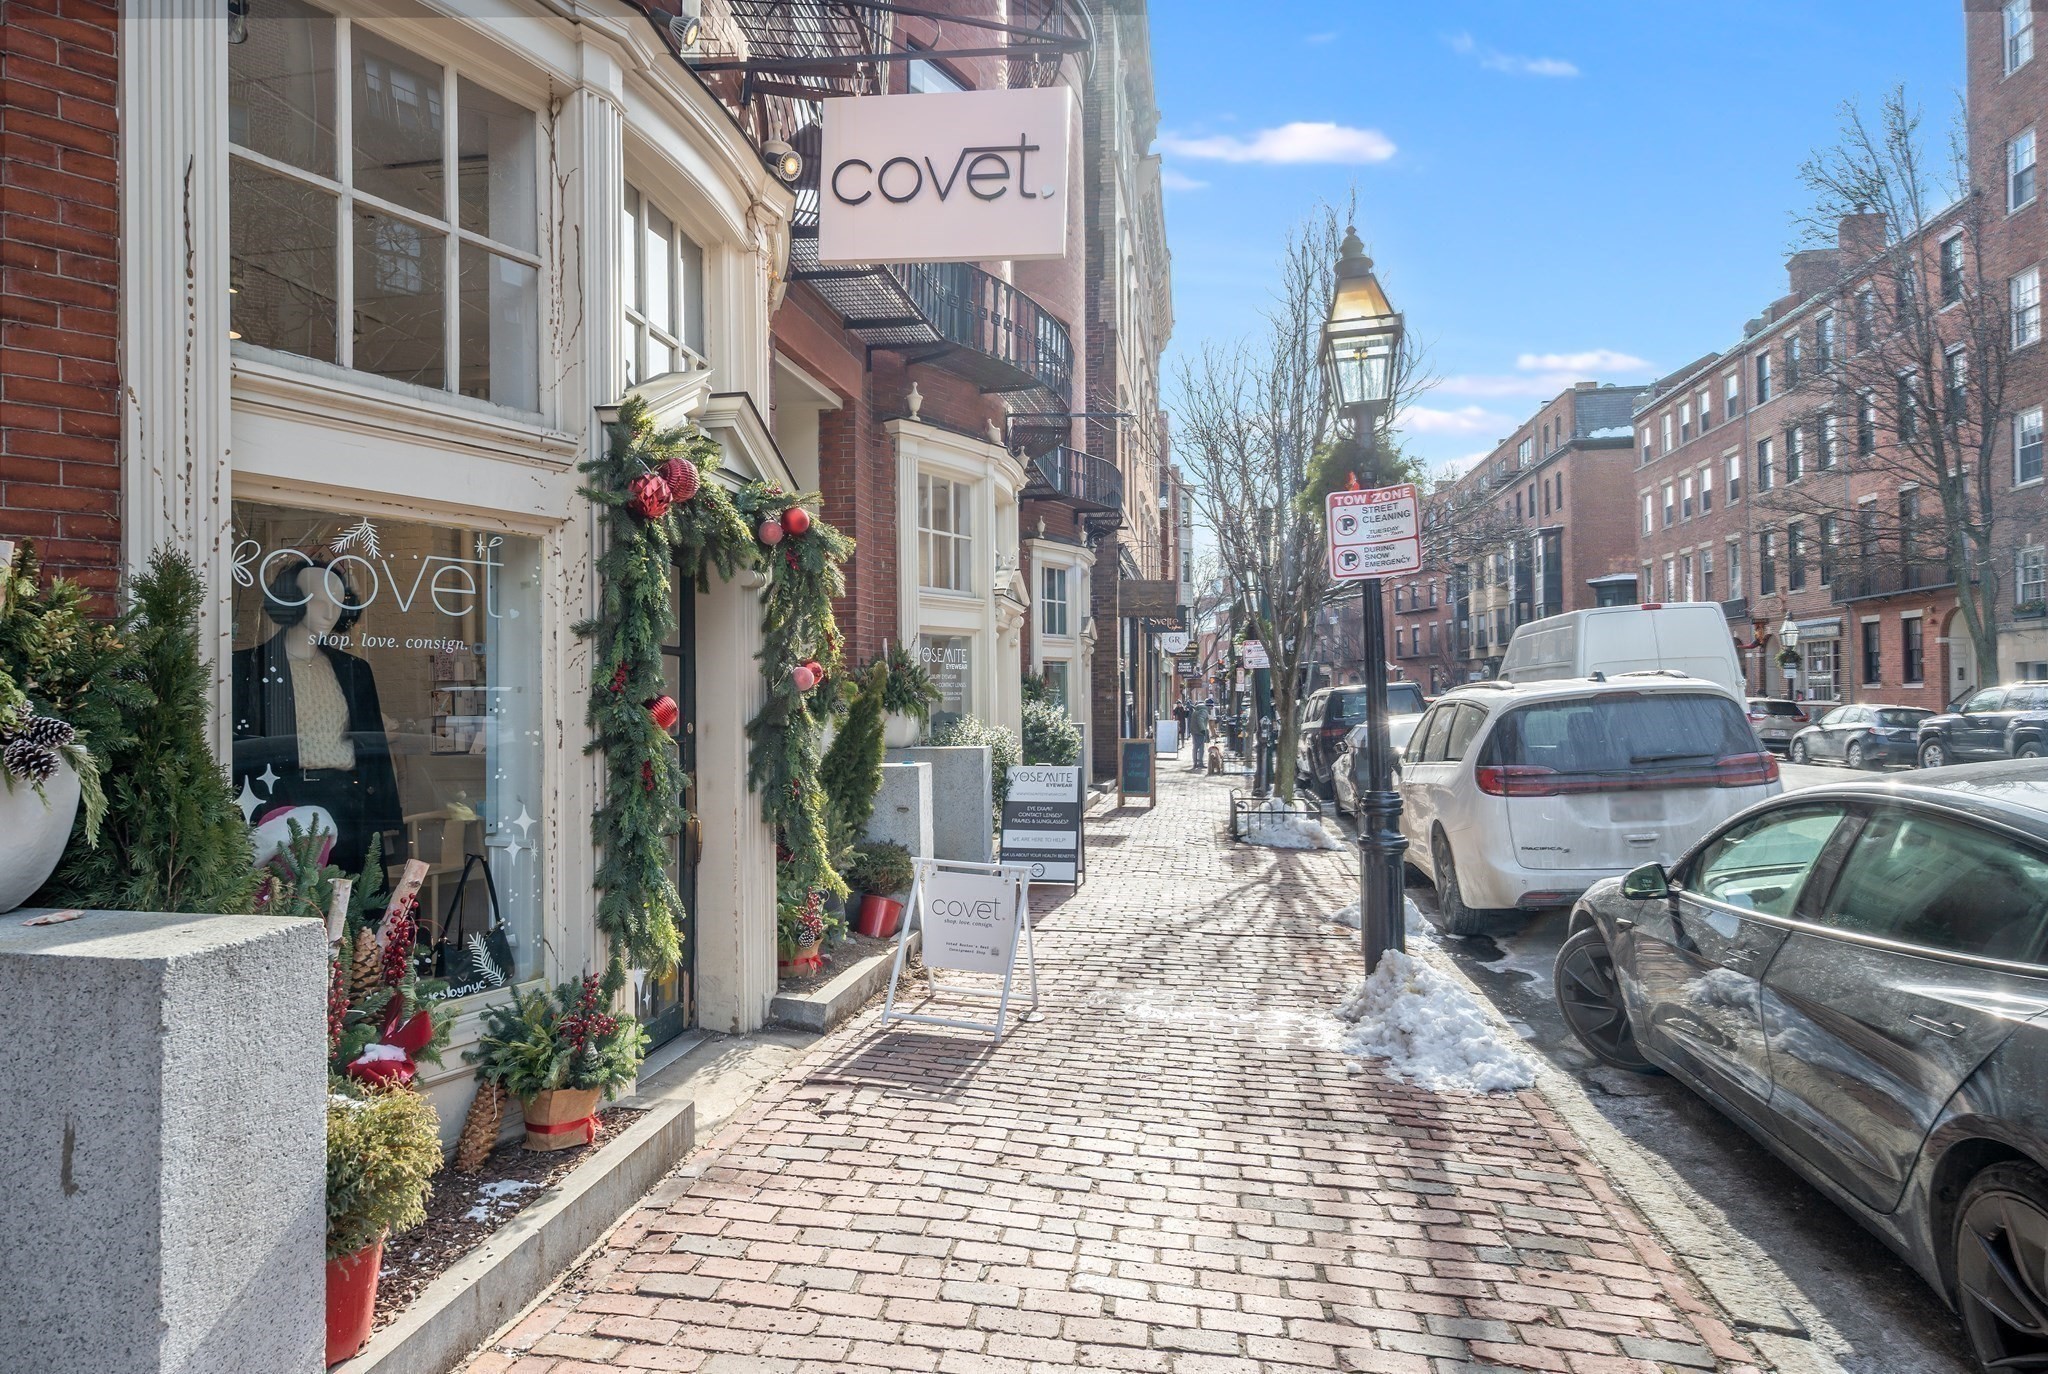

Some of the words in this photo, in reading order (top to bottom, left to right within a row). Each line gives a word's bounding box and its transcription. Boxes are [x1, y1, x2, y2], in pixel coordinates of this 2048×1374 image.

[1335, 494, 1366, 506] TOW
[1371, 487, 1411, 503] ZONE
[1362, 502, 1399, 514] STREET
[1362, 510, 1411, 523] CLEANING
[1369, 525, 1400, 534] TUESDAY
[1363, 544, 1395, 553] DURING
[1364, 552, 1390, 561] SNOW
[1364, 556, 1411, 568] EMERGENCY
[308, 632, 354, 650] shop.
[361, 633, 400, 648] love.
[405, 637, 469, 653] consign.
[1168, 636, 1182, 644] GR
[1012, 771, 1073, 783] YOSEMITE
